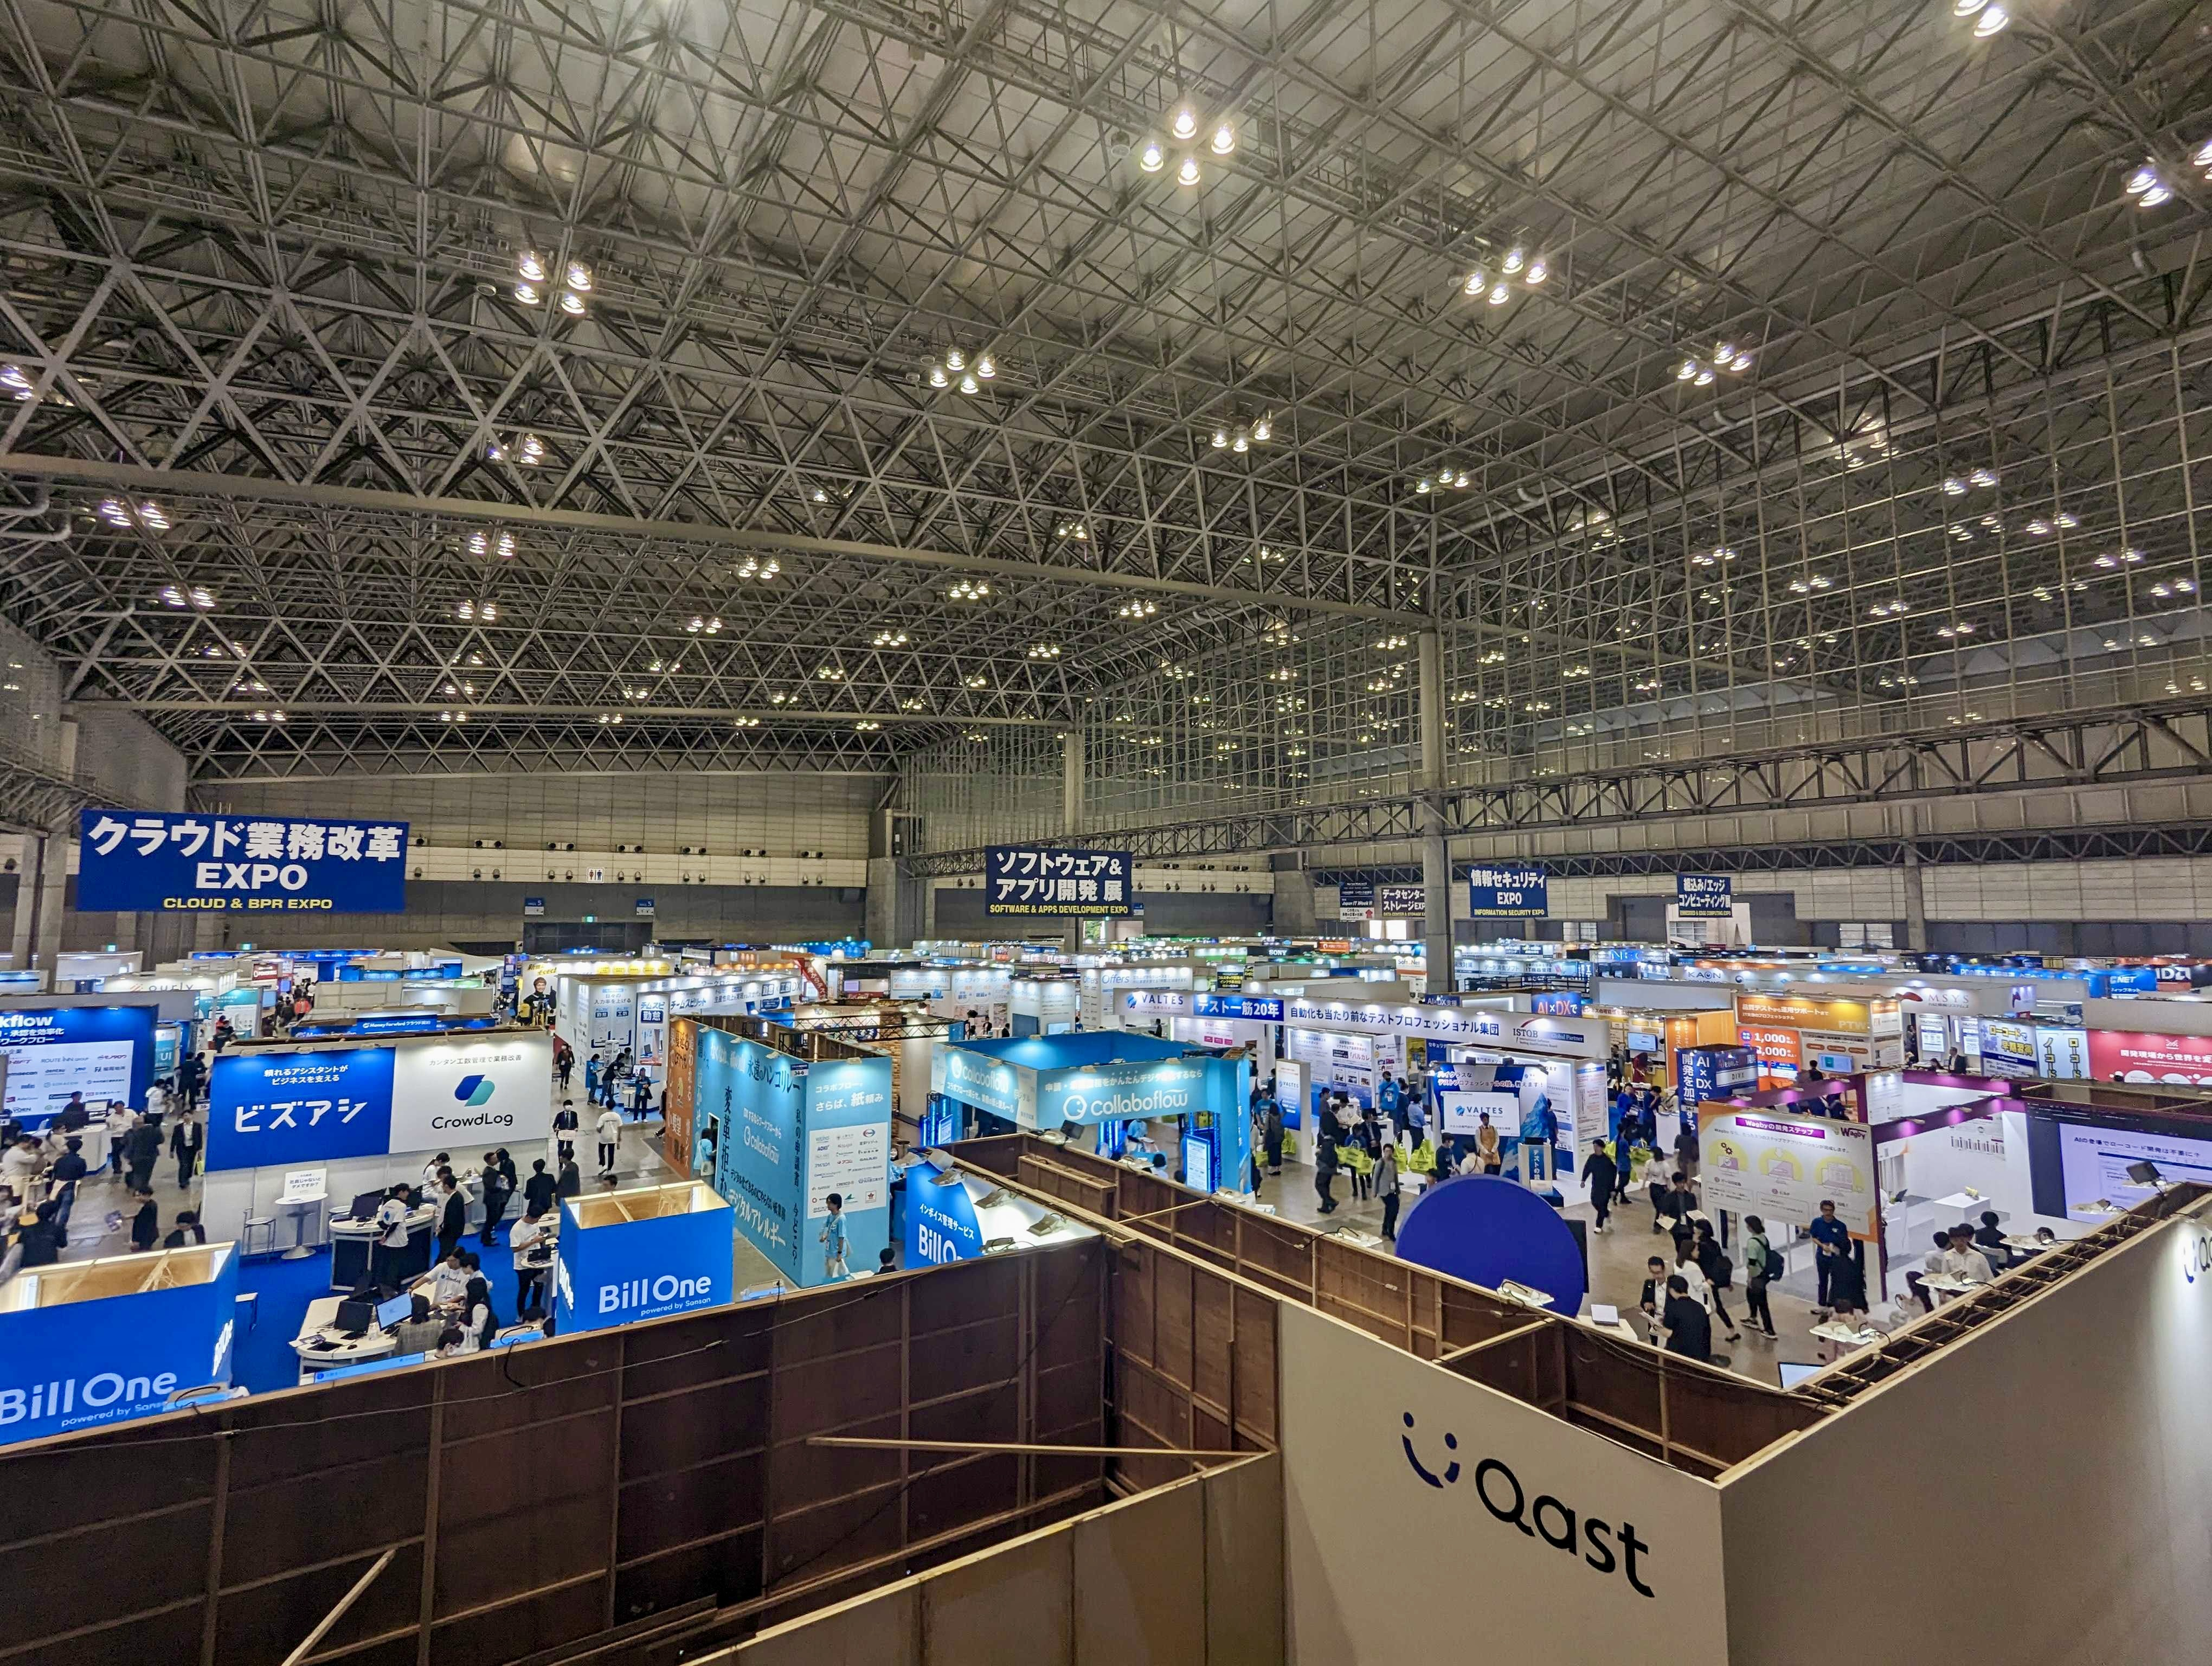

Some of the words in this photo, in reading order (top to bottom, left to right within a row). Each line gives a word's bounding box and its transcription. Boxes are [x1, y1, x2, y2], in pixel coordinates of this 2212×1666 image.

[88, 815, 403, 862] クラウド業務改革
[997, 852, 1122, 876] ソフトウェア&
[196, 862, 308, 891] EXPO
[1470, 869, 1546, 888] 情報セキュリティ
[1683, 877, 1725, 892] 組込み/エッジ
[997, 878, 1098, 902] アプリ開発
[1103, 880, 1122, 902] 展
[163, 897, 226, 909] CLOUD
[231, 898, 243, 909] &
[248, 898, 282, 909] BPR
[287, 898, 333, 910] EXPO
[1383, 901, 1425, 911] ストレージEXP
[1497, 891, 1522, 906] EXPO
[1679, 893, 1731, 908] コンピューティング展
[990, 904, 1029, 914] SOFTWARE
[1031, 905, 1036, 914] &
[1038, 905, 1057, 914] APPS
[1059, 905, 1109, 914] DEVELOPMENT
[1110, 905, 1128, 914] EXPO
[148, 982, 193, 991] ourly
[1102, 974, 1129, 984] Offers
[671, 997, 707, 1010] チームスピリット
[1142, 994, 1183, 1005] VALTES
[1928, 994, 1969, 1004] MSYS
[642, 1011, 661, 1021] 勤怠
[1197, 1000, 1280, 1018] テスト一筋20年
[1537, 1000, 1577, 1016] AI×DXで
[0, 1015, 53, 1028] kflow
[1290, 1006, 1499, 1037] 自動化も当たり前なテストプロフェッショナル集団
[1839, 1020, 1867, 1030] PTW
[1513, 1028, 1538, 1038] ISTQB
[1755, 1032, 1787, 1043] 1,000
[161, 1052, 171, 1061] UI
[429, 1054, 522, 1066] カンタン工数管理で業務改善
[2120, 1049, 2212, 1064] 開発現場から世界を変
[264, 1064, 349, 1078] 頼れるアシスタントが
[747, 1054, 800, 1093] 永遠のハンコリレー
[271, 1074, 340, 1086] ビジネスを支える
[962, 1065, 1009, 1095] collaboflow
[1045, 1071, 1203, 1093] 申請・務をかんたんデジタル化するなら
[1682, 1054, 1696, 1130] 開発を加する
[815, 1091, 883, 1112] さらば、紙頼み
[1090, 1089, 1188, 1116] collaboflow
[236, 1097, 368, 1132] ビズアシ
[1466, 1106, 1504, 1114] VALTES
[432, 1113, 513, 1130] CrowdLog
[1744, 1119, 1814, 1136] Wagbyの開発ステップ
[1841, 1127, 1867, 1140] Wagby
[919, 1202, 975, 1241] インボイス管理サービス
[918, 1223, 941, 1263] Bill
[599, 1278, 648, 1313] Bill
[653, 1275, 712, 1302] One
[641, 1304, 673, 1317] powered
[685, 1297, 711, 1306] Sansan
[0, 1378, 75, 1425] Bill
[82, 1372, 177, 1407] One
[61, 1408, 113, 1427] powered
[117, 1408, 130, 1416] by
[135, 1401, 168, 1412] Sans
[1475, 1458, 1655, 1598] Qast
